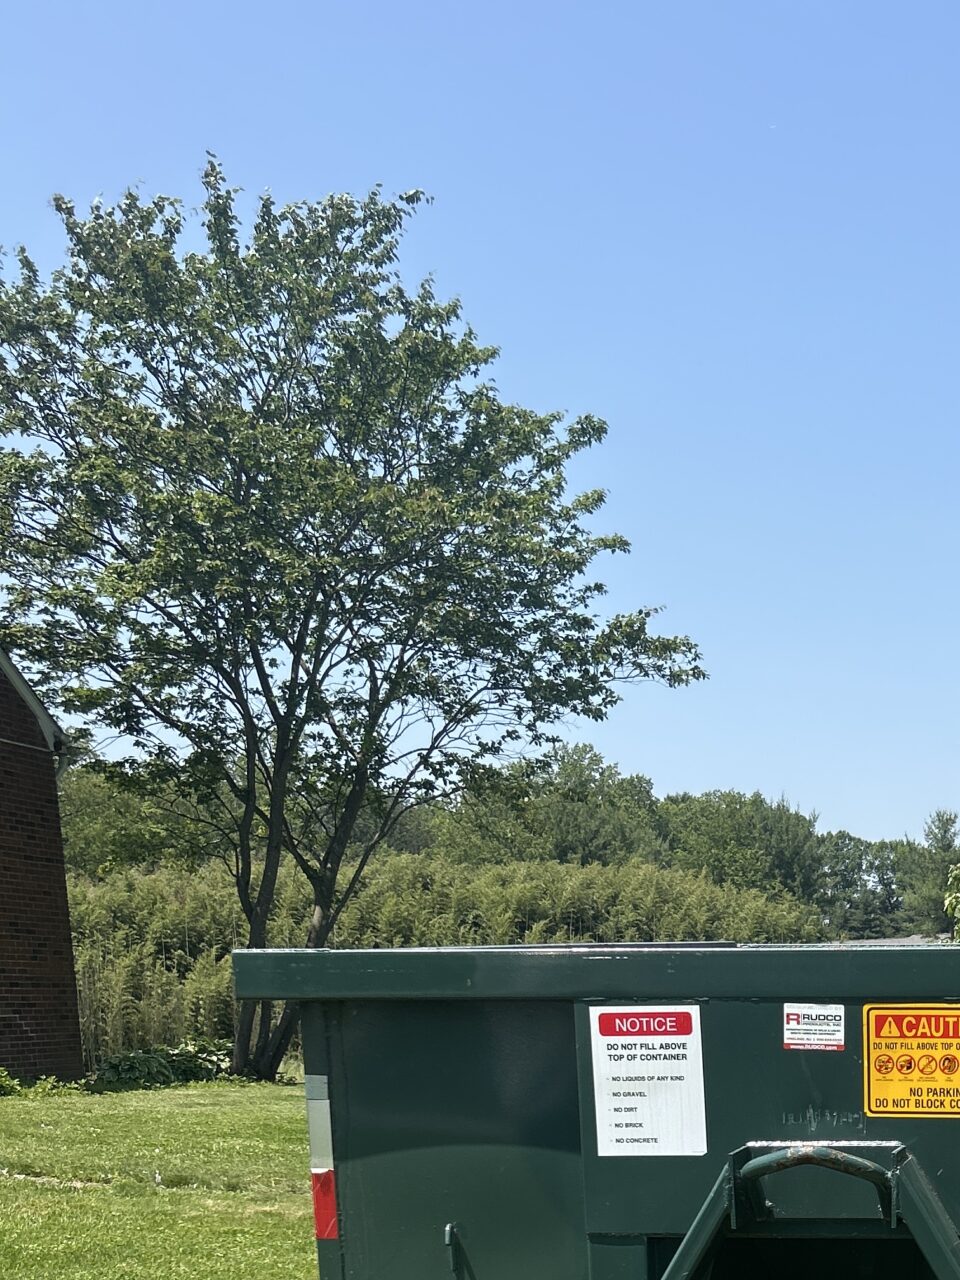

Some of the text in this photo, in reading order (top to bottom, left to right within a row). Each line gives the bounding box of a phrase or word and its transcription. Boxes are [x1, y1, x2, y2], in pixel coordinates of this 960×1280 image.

[786, 1013, 800, 1025] R
[615, 1018, 677, 1031] NOTICE
[910, 1088, 922, 1096] NO
[876, 1099, 888, 1108] DO
[892, 1099, 910, 1108] NOT
[915, 1099, 945, 1108] BLOCK
